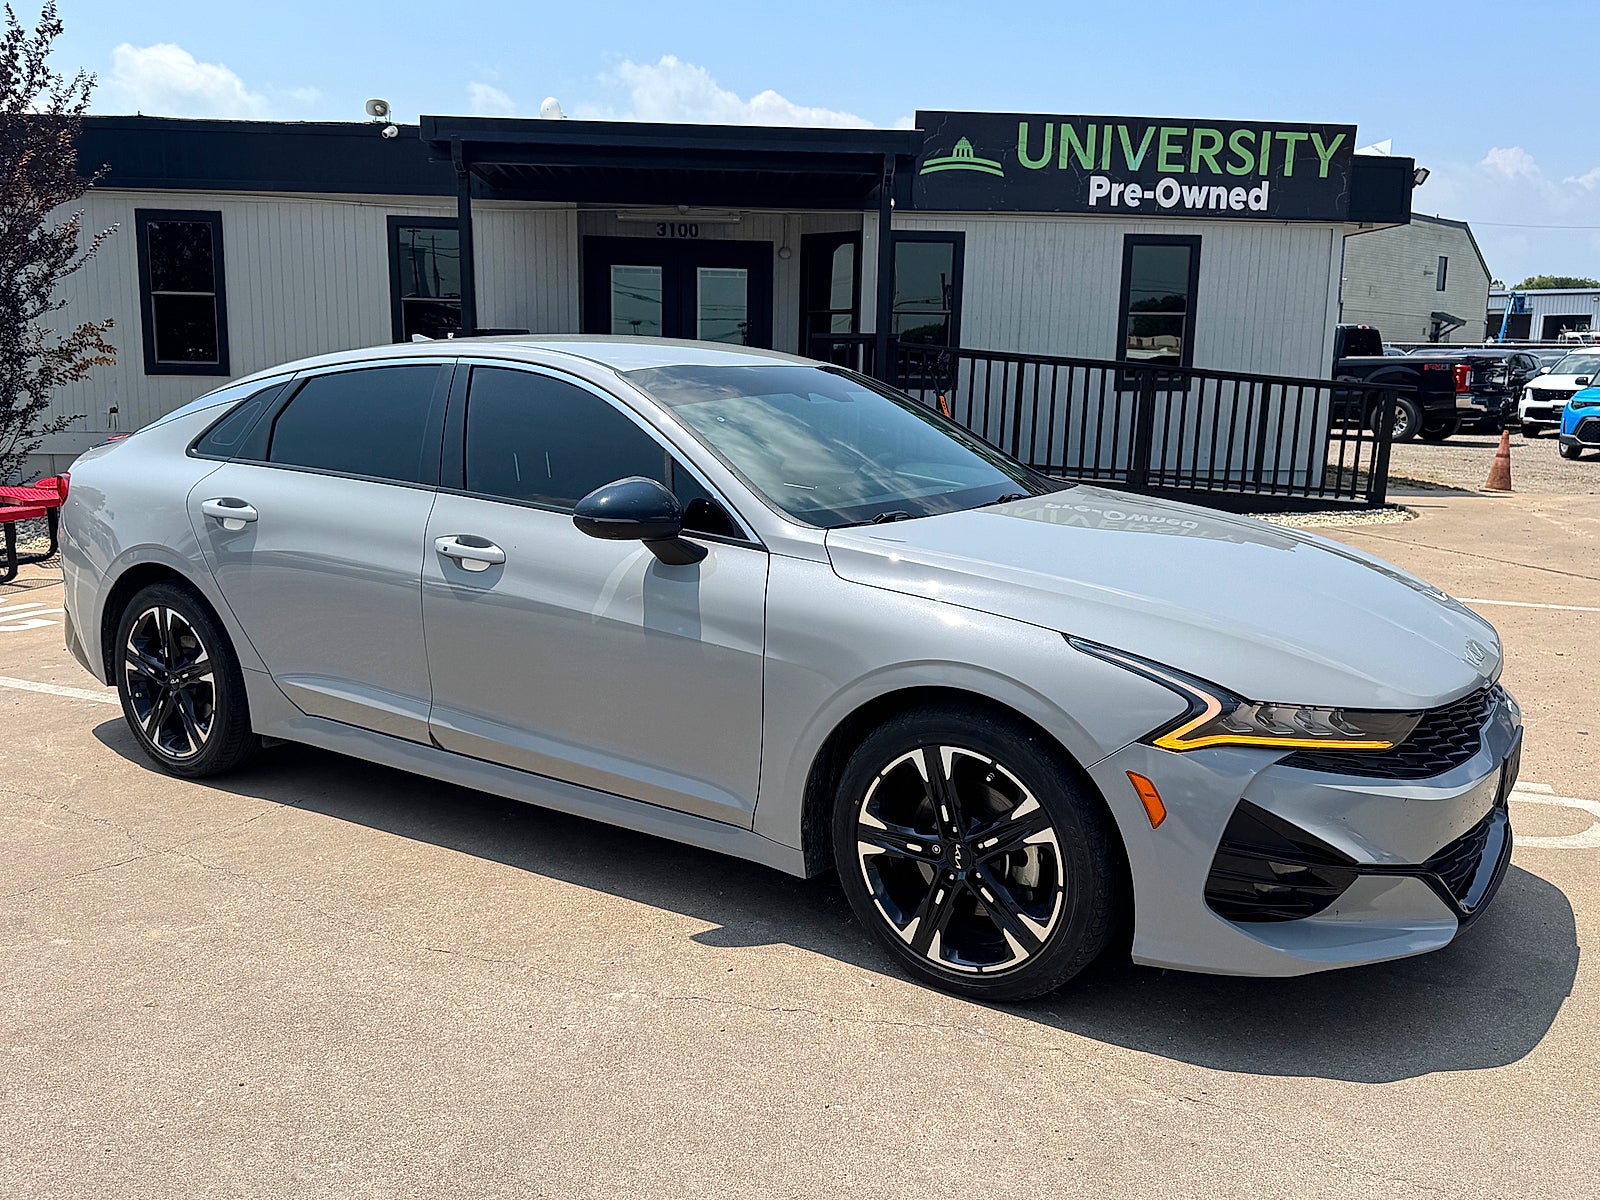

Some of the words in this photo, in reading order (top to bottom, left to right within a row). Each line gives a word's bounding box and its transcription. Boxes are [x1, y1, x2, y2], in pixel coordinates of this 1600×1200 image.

[1017, 122, 1346, 178] UNIVERSITY
[1088, 176, 1269, 211] Pre-Owned
[656, 223, 699, 237] 3100
